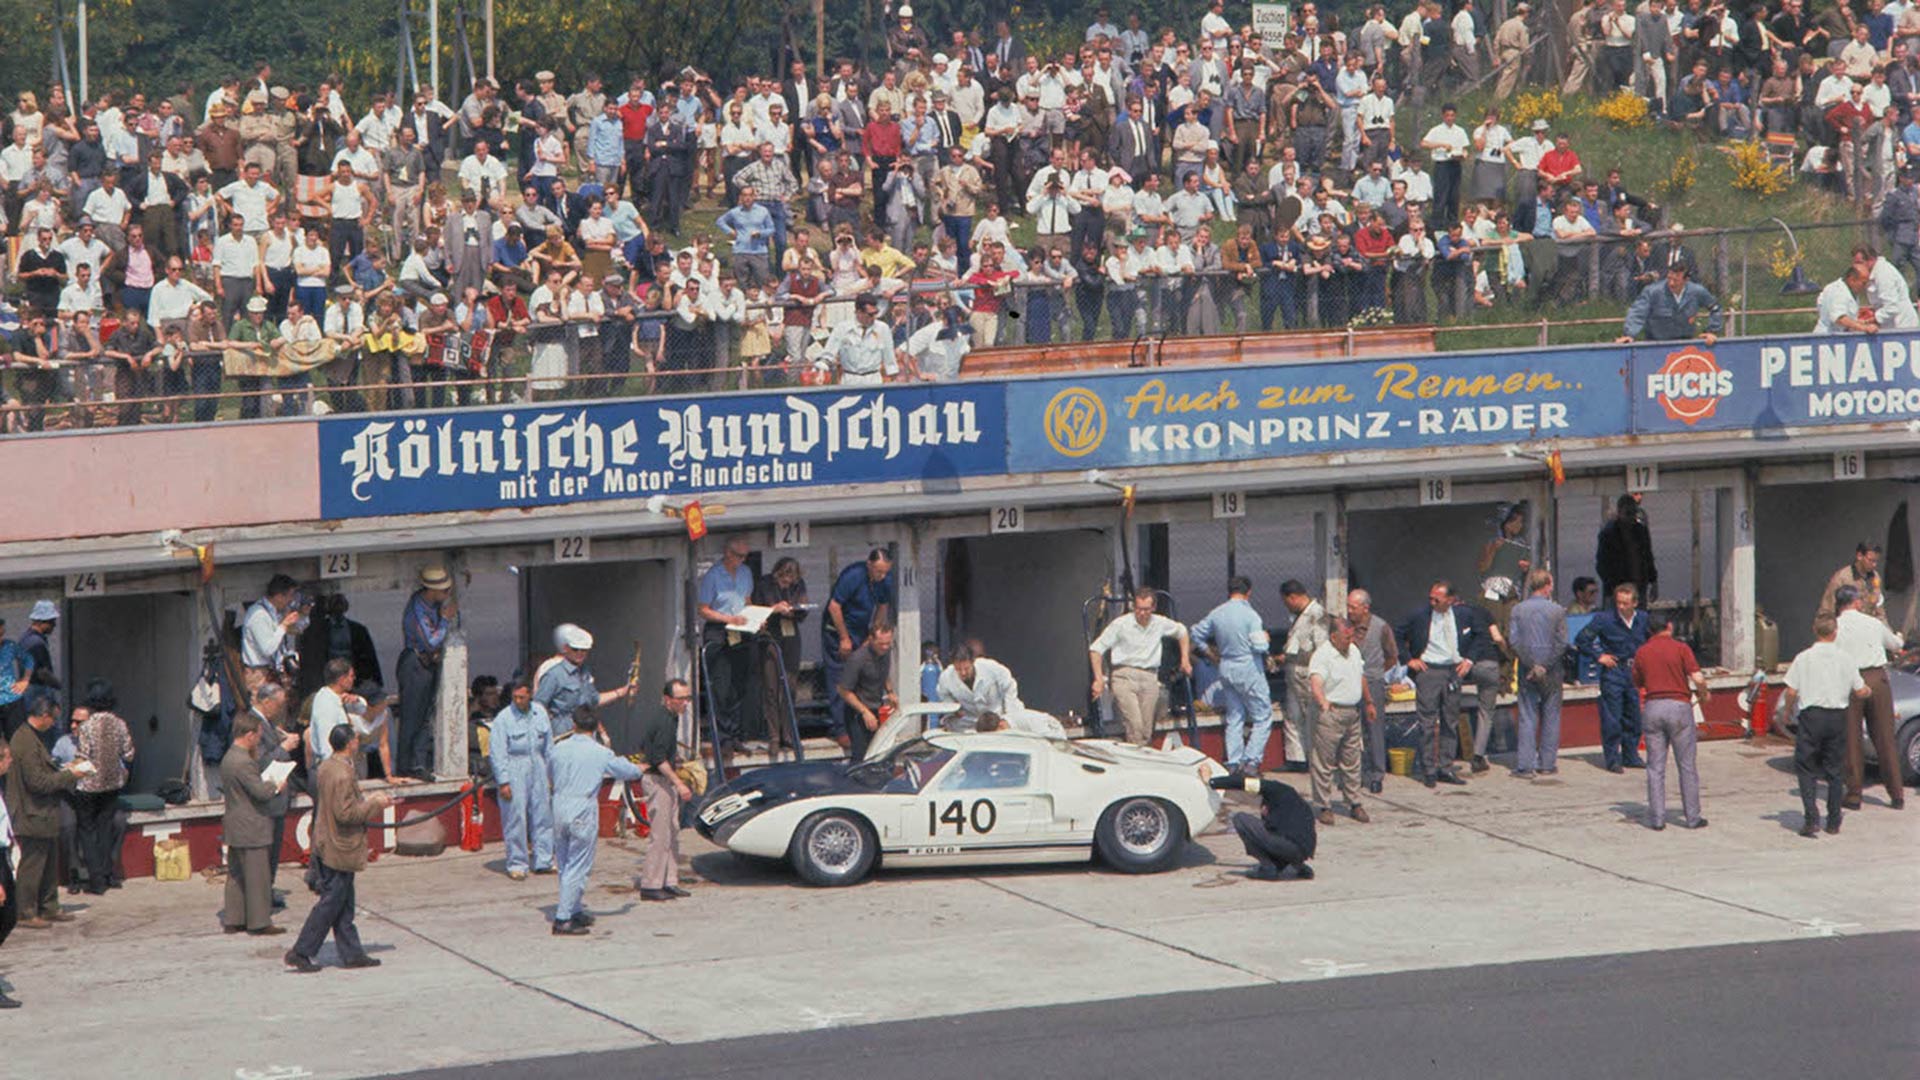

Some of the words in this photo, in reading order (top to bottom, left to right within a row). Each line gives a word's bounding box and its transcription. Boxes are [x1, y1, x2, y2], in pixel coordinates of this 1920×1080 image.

[1647, 370, 1734, 398] FUCHS
[1124, 379, 1240, 419] Auch
[1258, 384, 1354, 408] zum
[1129, 402, 1569, 452] KRONPRINZ-RÄDER
[1842, 454, 1858, 475] 16
[500, 473, 537, 499] mit
[549, 470, 589, 496] der
[603, 461, 813, 492] Motor-Rundschau
[1634, 466, 1650, 487] 17
[1428, 480, 1444, 500] 18
[1221, 493, 1237, 513] 19
[998, 507, 1018, 528] 20
[782, 523, 801, 544] 21
[561, 537, 584, 558] 22
[328, 553, 350, 573] 23
[74, 569, 97, 591] 24
[928, 798, 997, 837] 140
